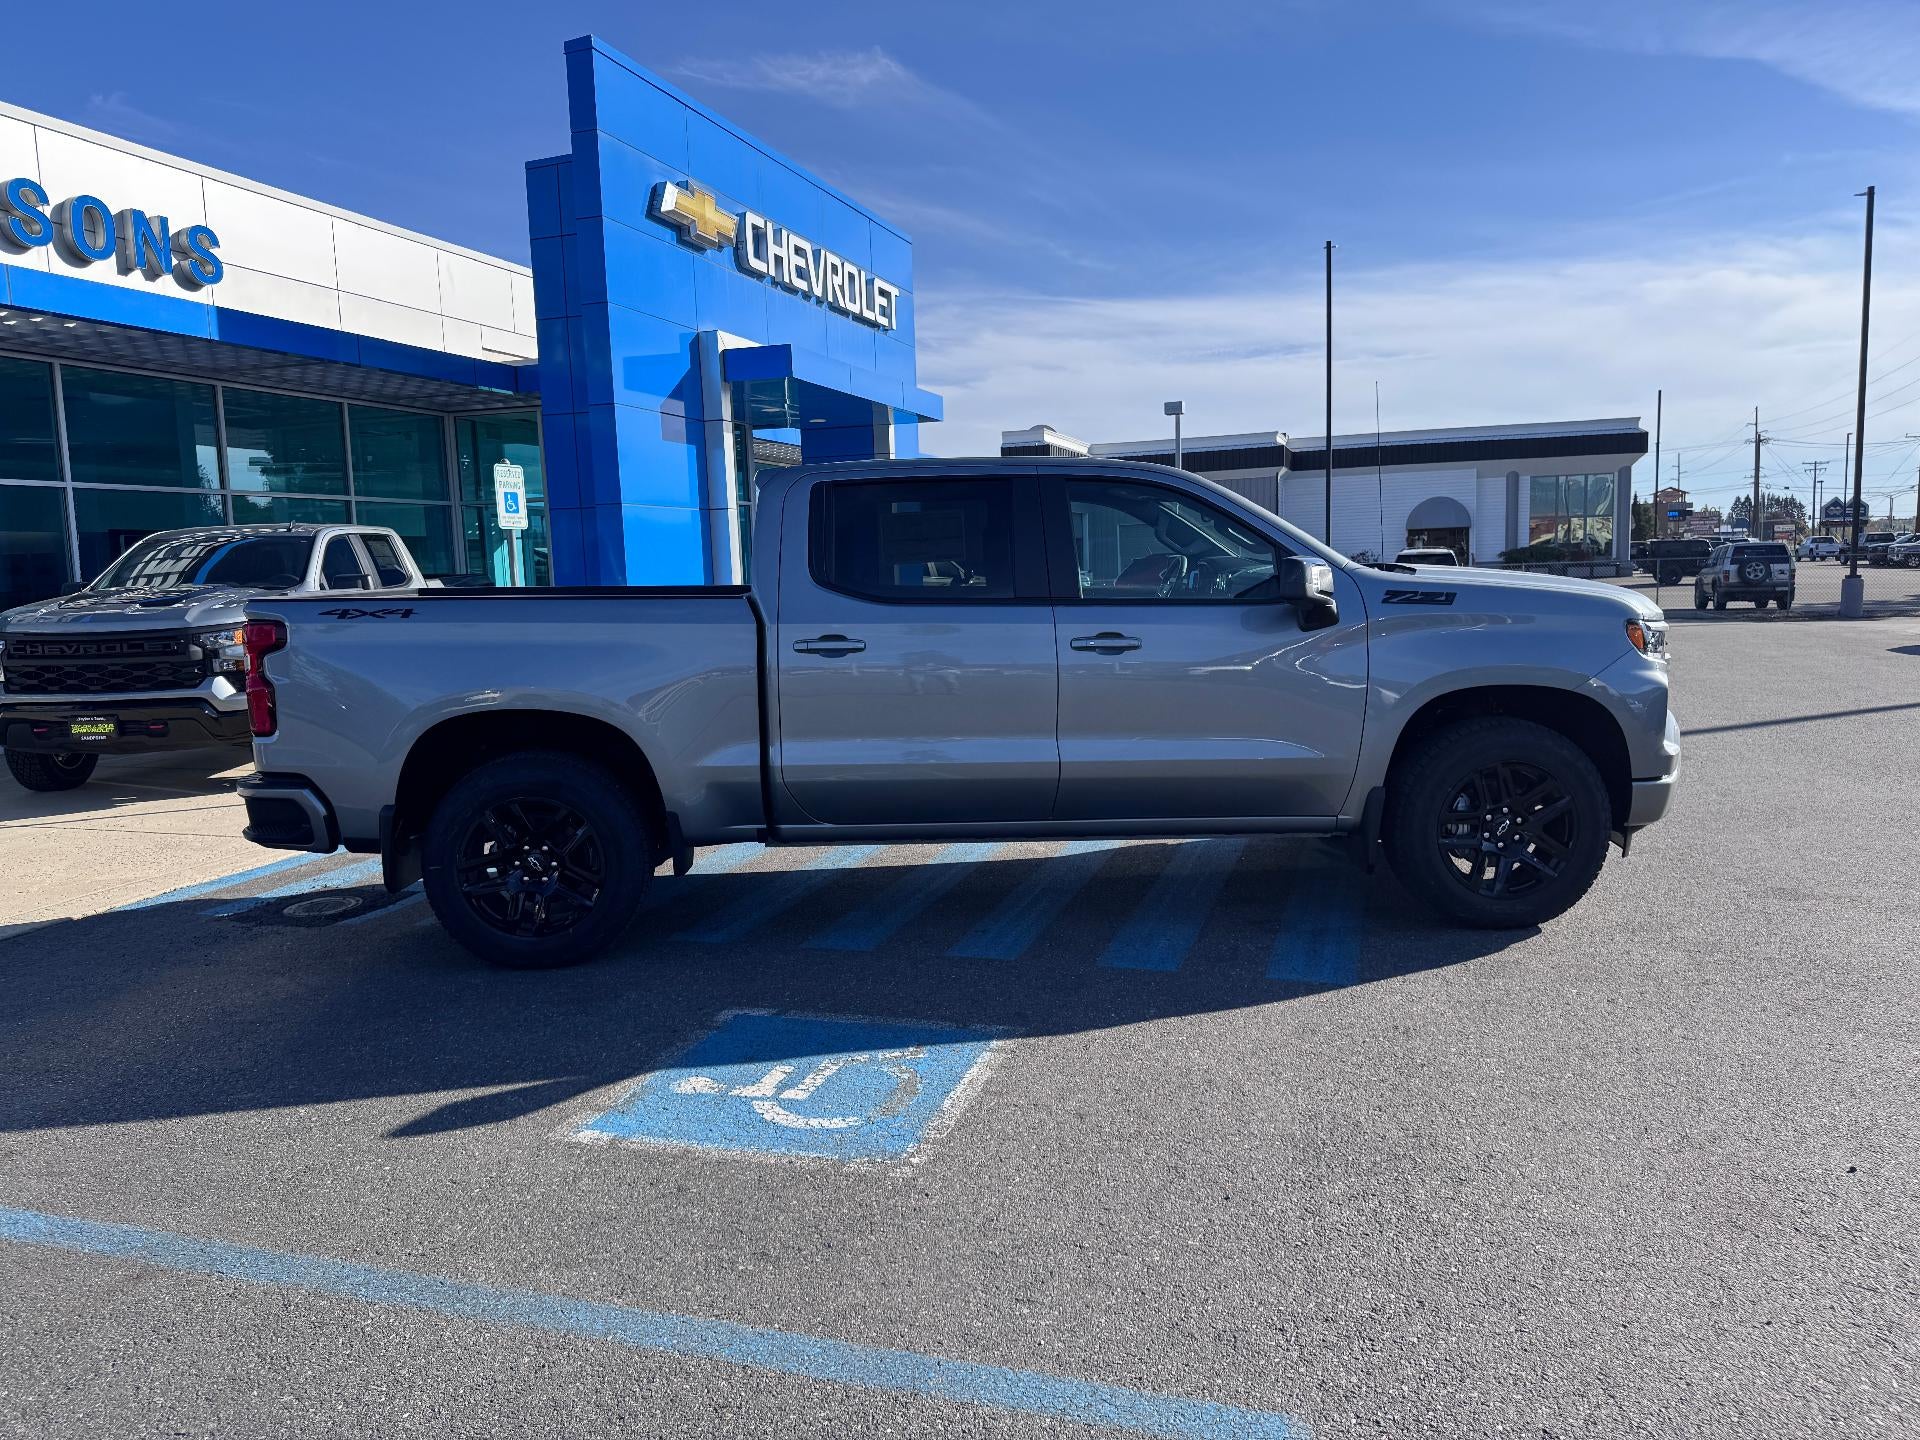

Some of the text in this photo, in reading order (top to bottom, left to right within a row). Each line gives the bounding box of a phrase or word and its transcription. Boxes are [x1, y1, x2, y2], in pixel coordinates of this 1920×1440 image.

[5, 177, 224, 286] SONS
[744, 210, 900, 331] CHEVROLET
[496, 469, 521, 479] RESERVED
[499, 481, 521, 490] PARKING
[1381, 589, 1458, 606] Z71
[9, 640, 183, 656] CHEVROLET
